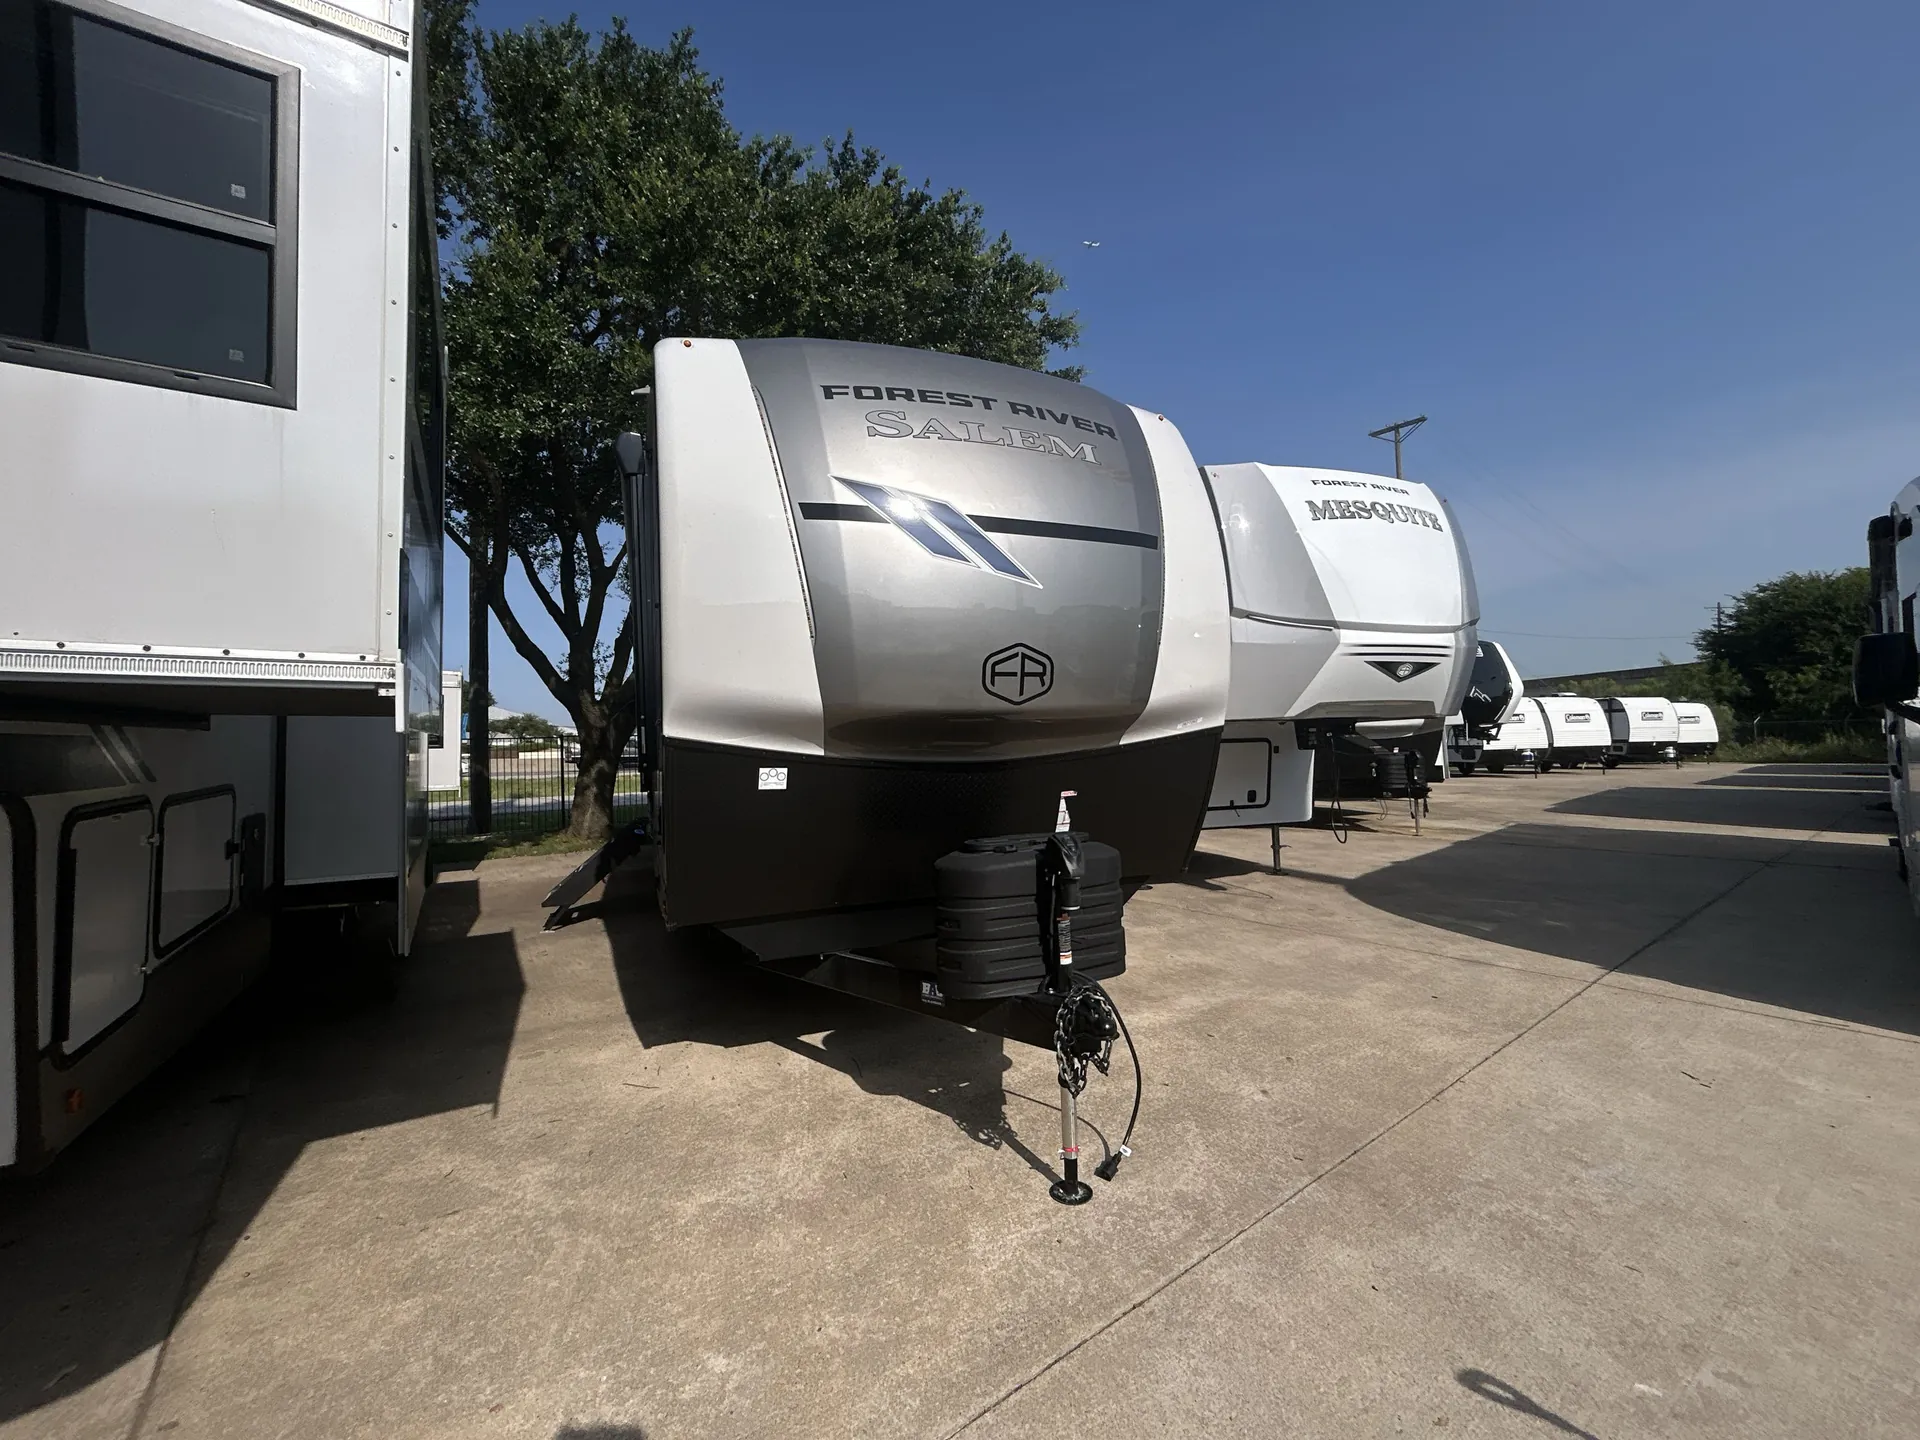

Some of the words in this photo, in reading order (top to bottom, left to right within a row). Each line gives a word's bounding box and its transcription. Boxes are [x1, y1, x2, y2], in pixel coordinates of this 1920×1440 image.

[820, 384, 998, 410] FOREST
[1007, 400, 1119, 441] RIVER
[864, 409, 1102, 465] SALEM
[1310, 479, 1367, 488] FOREST
[1370, 483, 1410, 496] RIVER
[1304, 499, 1443, 532] MESQUITE
